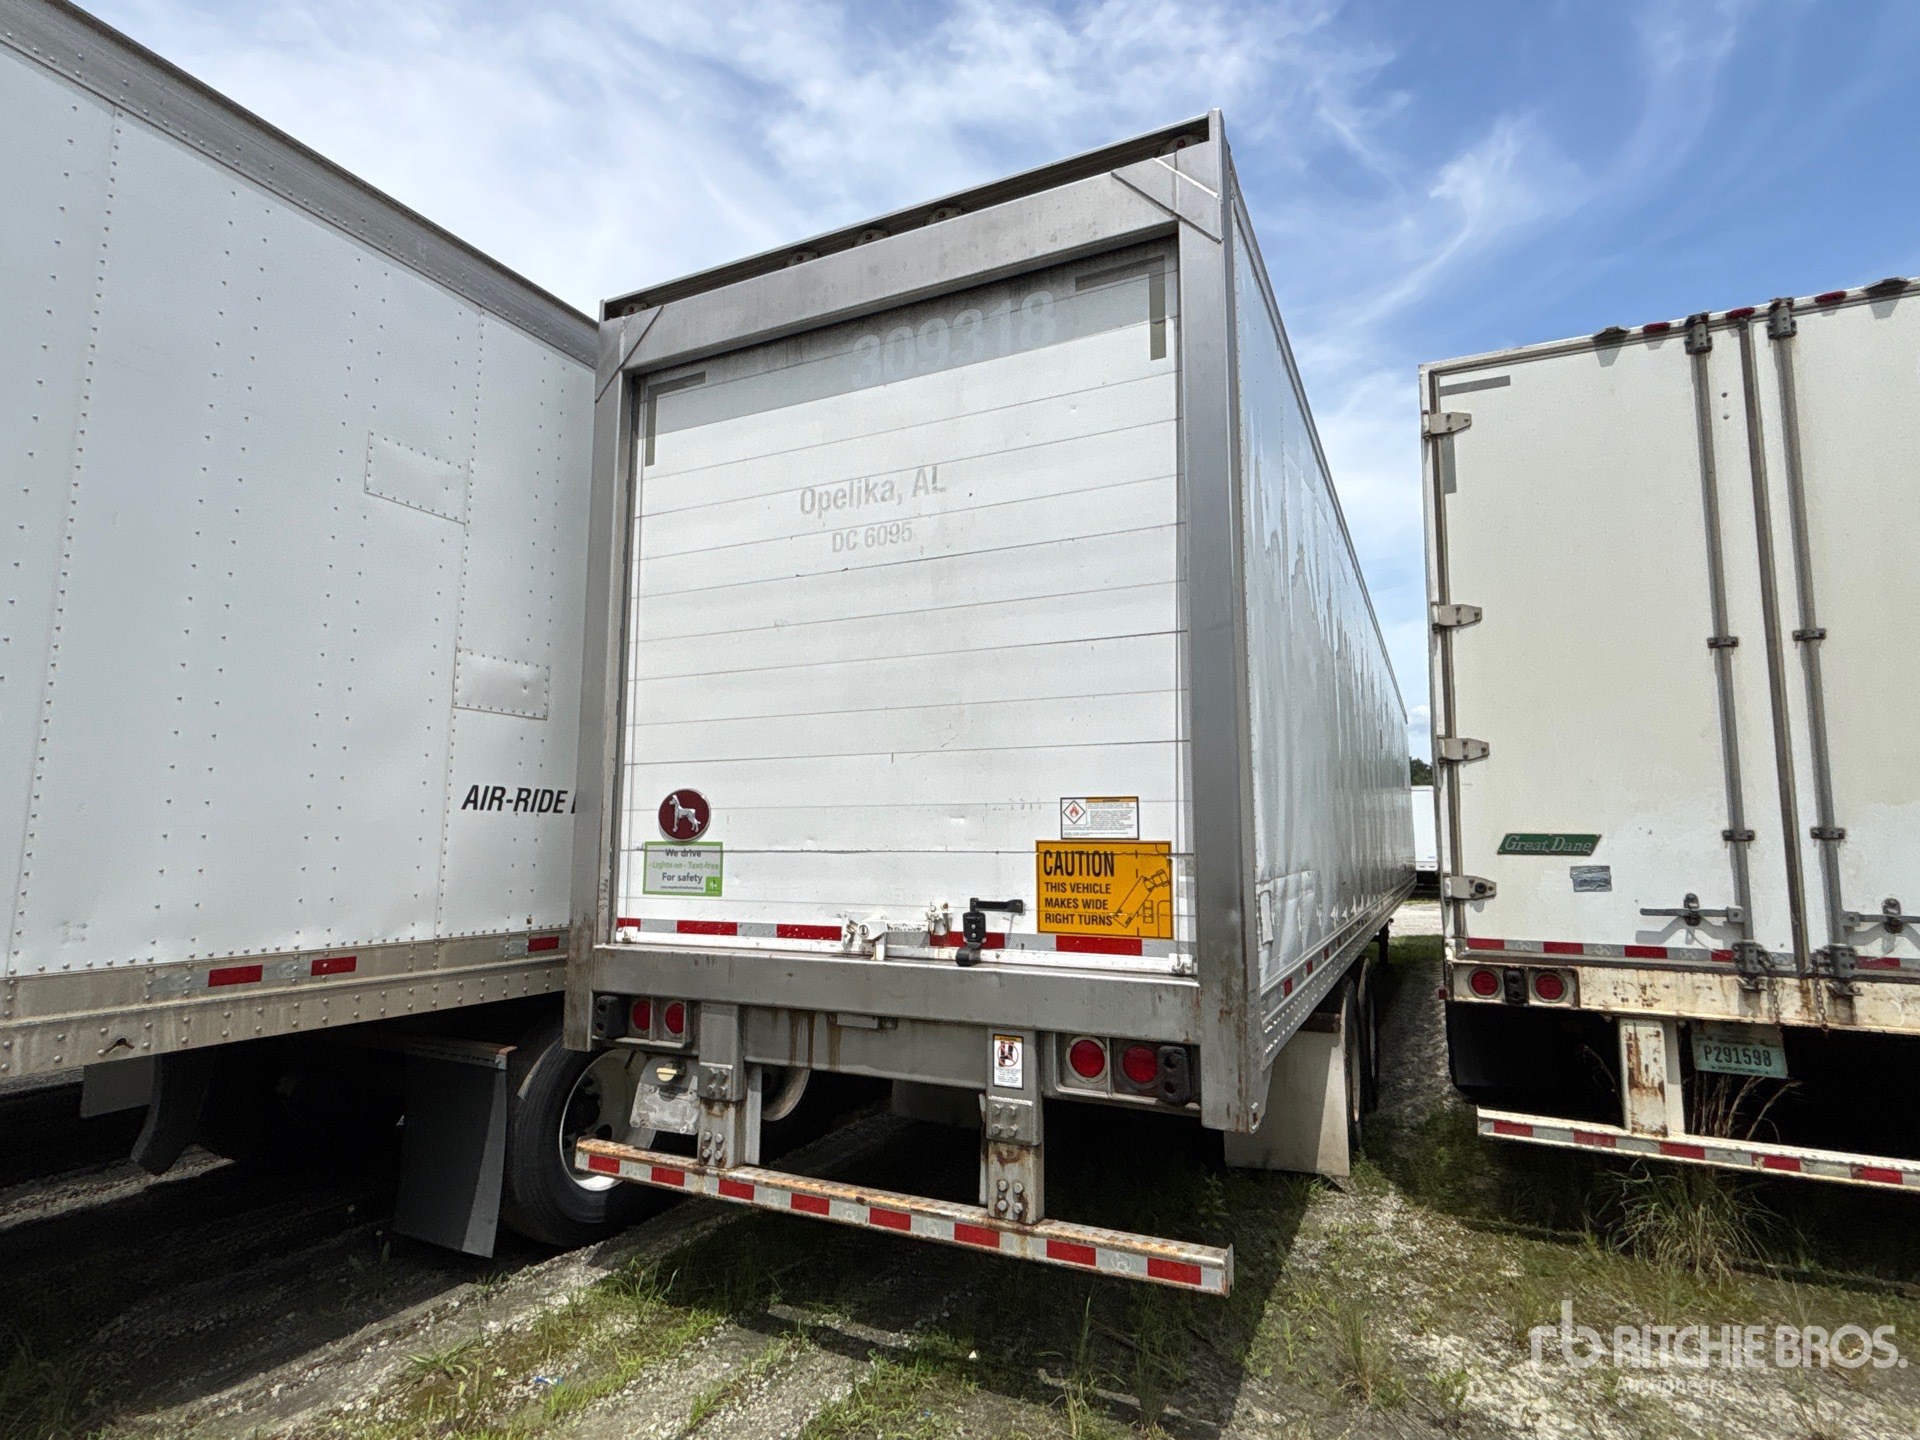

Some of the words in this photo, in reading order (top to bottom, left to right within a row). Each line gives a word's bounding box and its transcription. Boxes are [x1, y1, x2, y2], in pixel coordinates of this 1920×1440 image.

[911, 465, 947, 498] AL
[832, 529, 858, 553] DC
[864, 521, 913, 548] 6095
[461, 784, 568, 814] AIR-RIDE
[1504, 835, 1549, 852] Great
[1550, 836, 1592, 852] Dane
[665, 848, 678, 857] We
[680, 848, 702, 857] drive
[1043, 849, 1115, 877] CAUTION
[661, 872, 676, 881] For
[677, 872, 703, 884] safety
[1044, 882, 1067, 893] THIS
[1069, 882, 1112, 895] VEHICLE
[1044, 897, 1079, 909] MAKES
[1081, 898, 1109, 910] WIDE
[1044, 912, 1076, 924] RIGHT
[1078, 913, 1113, 926] TURNS
[1703, 1045, 1773, 1067] P291598
